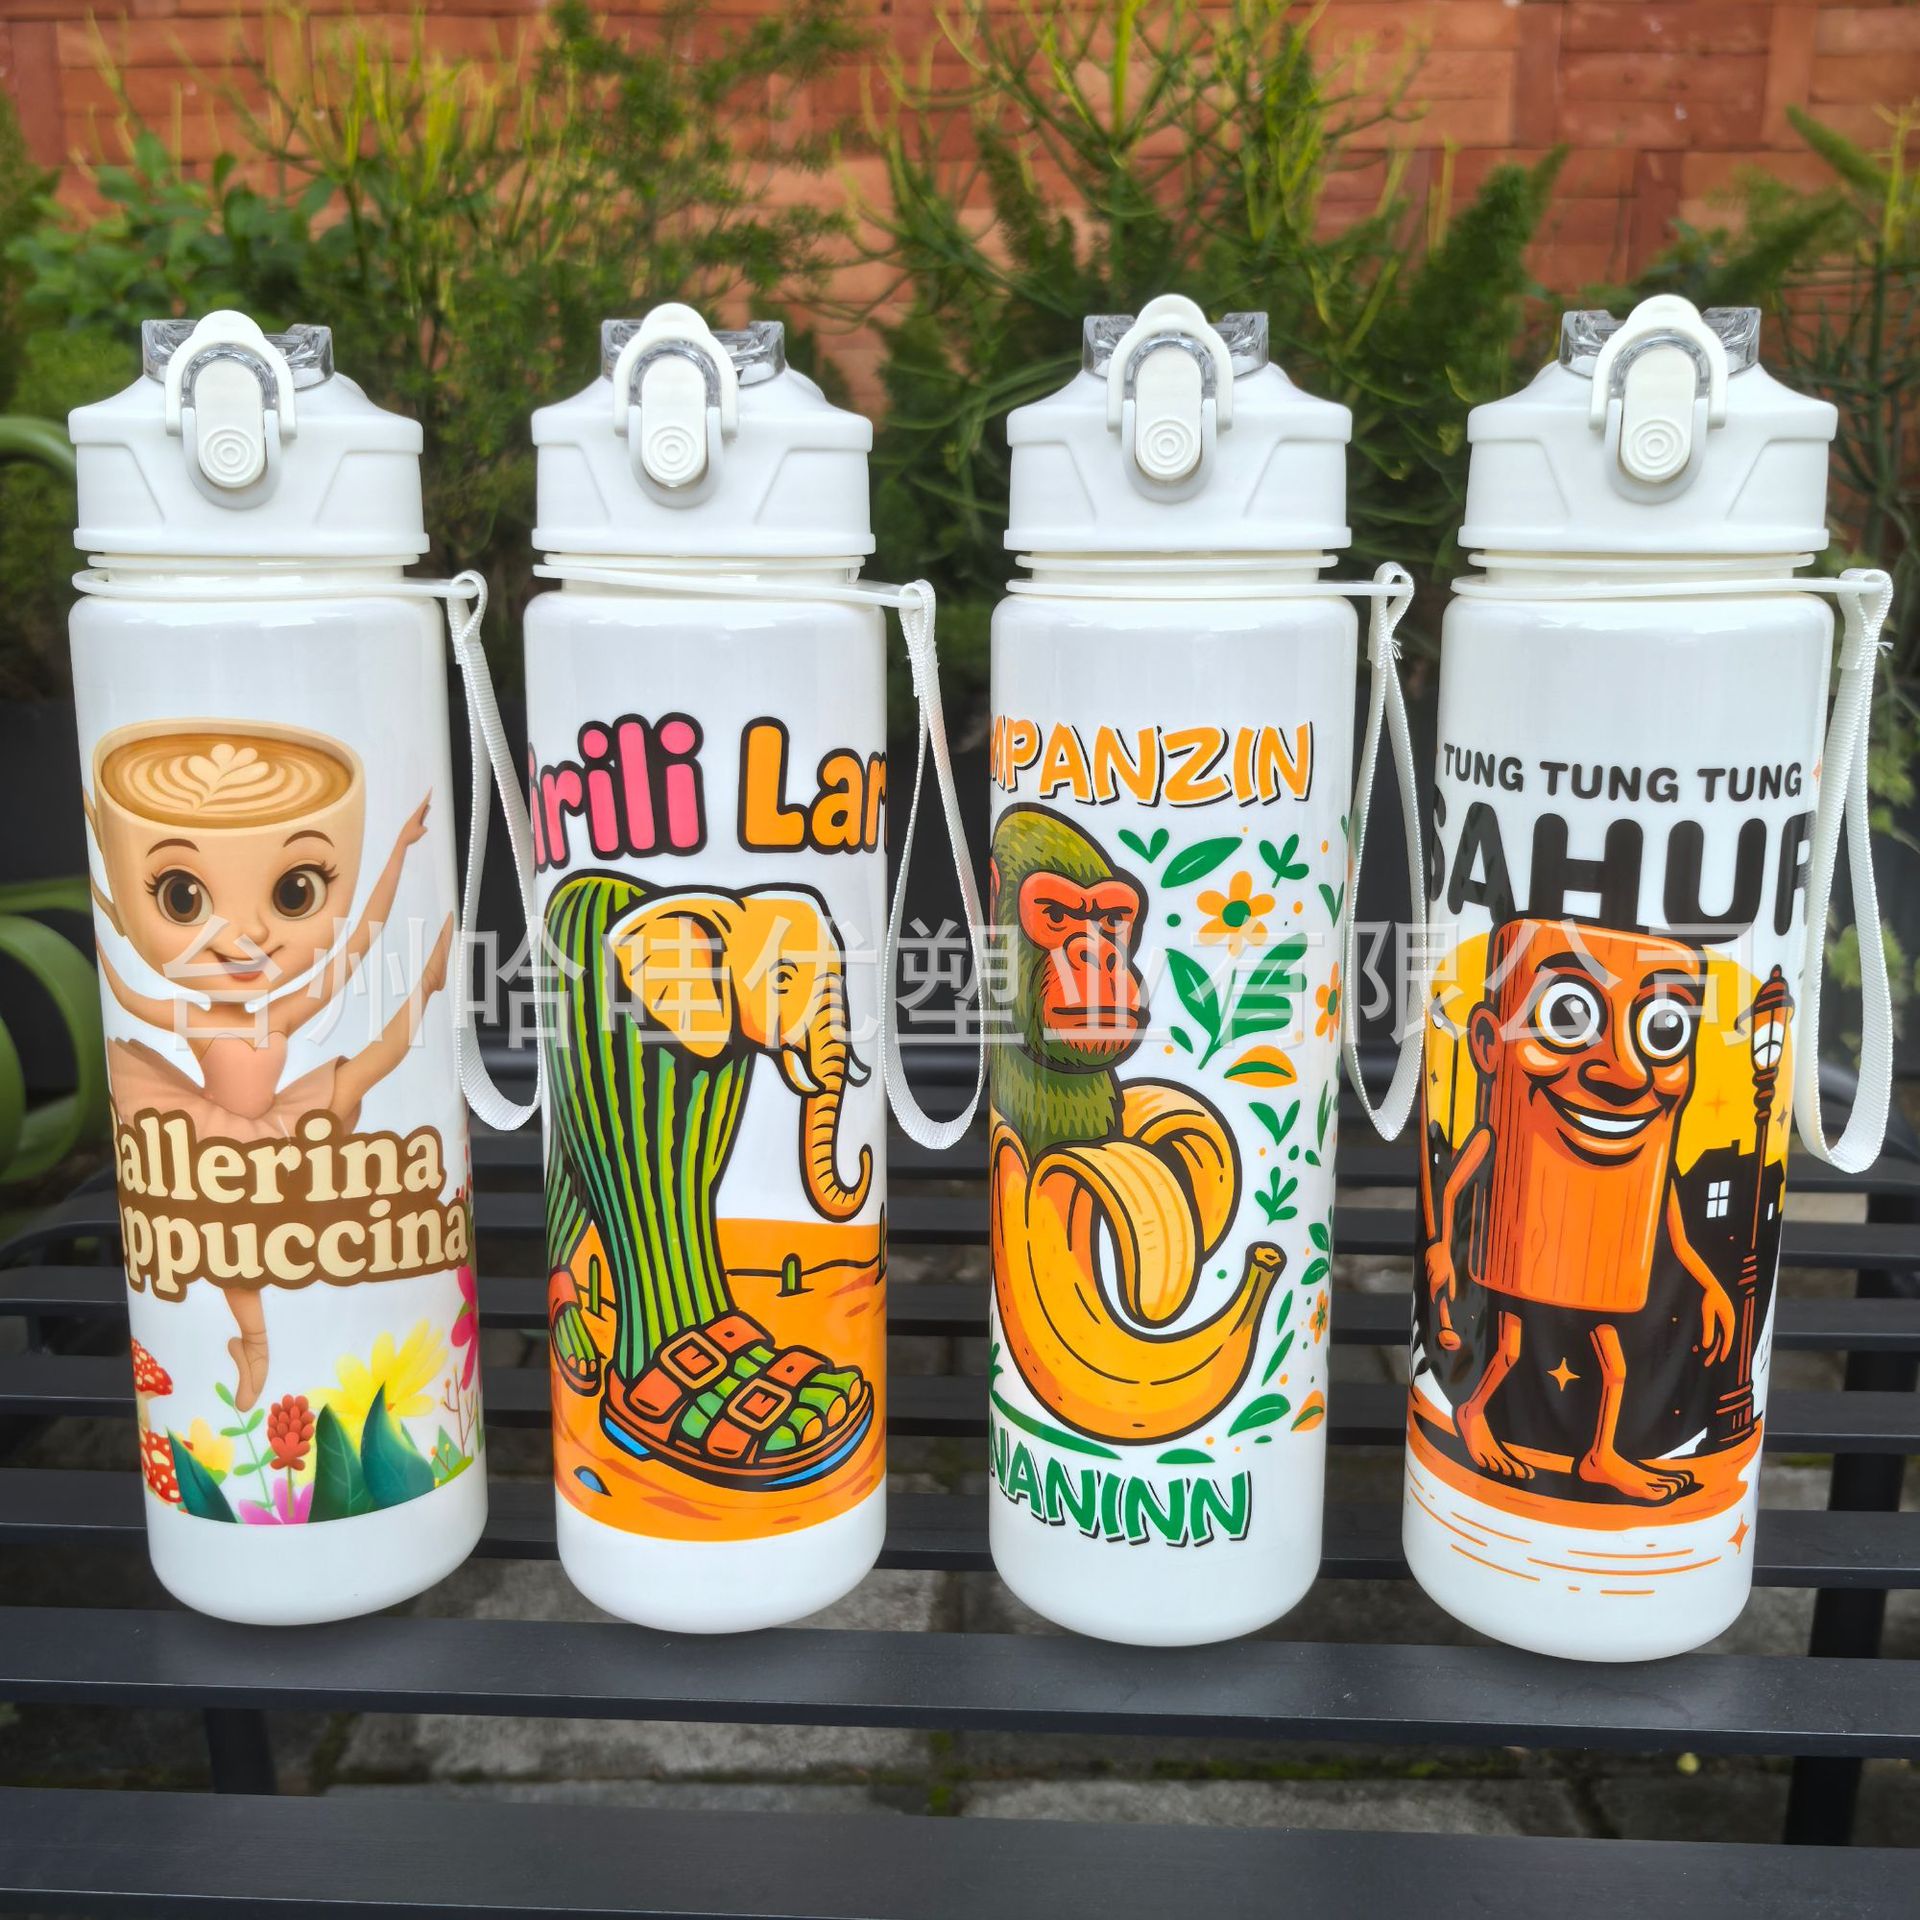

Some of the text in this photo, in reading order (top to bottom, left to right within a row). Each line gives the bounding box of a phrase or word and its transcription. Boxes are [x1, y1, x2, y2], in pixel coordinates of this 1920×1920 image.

[737, 716, 887, 855] Lar
[1444, 743, 1801, 803] TUNG TUNG TUNG
[110, 1104, 444, 1204] allerina
[119, 1198, 469, 1294] ppuccina
